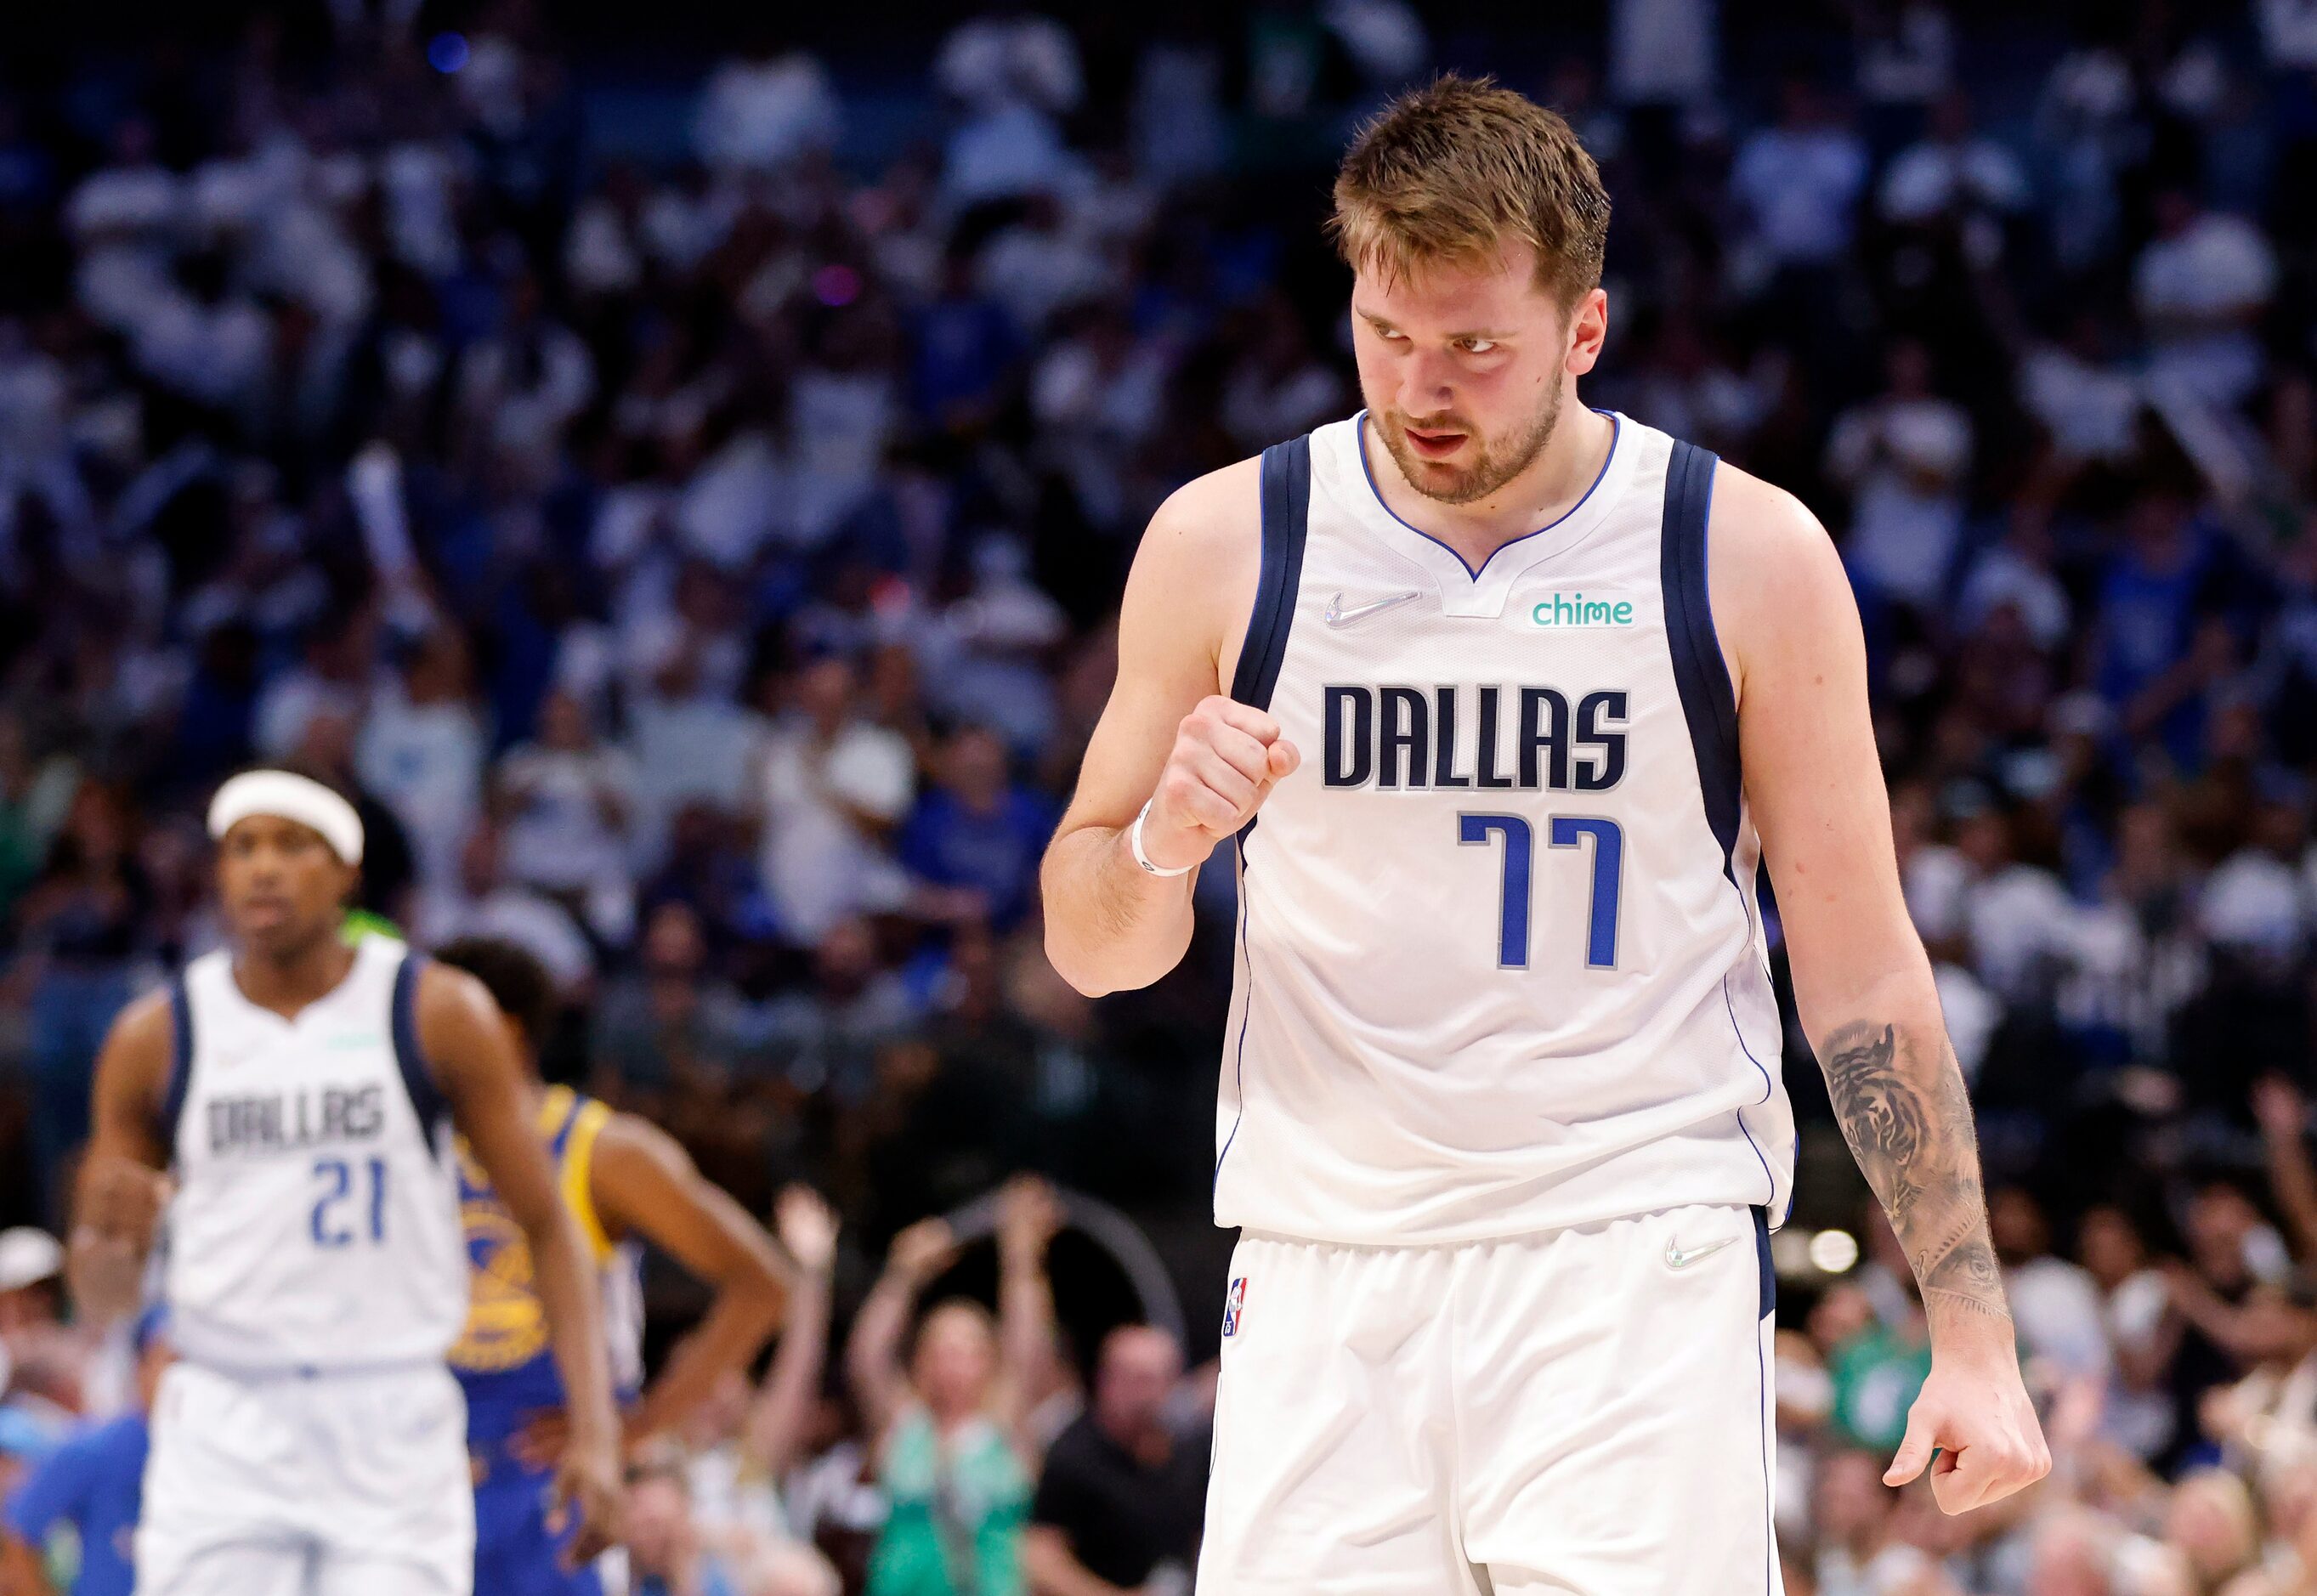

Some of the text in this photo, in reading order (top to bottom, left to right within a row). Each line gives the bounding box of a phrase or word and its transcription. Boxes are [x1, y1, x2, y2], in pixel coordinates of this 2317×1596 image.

[1532, 593, 1633, 625] chime
[1323, 684, 1629, 794] DALLAS
[1457, 810, 1625, 971] 77
[208, 1083, 385, 1155] DALLAS
[311, 1157, 386, 1246] 21
